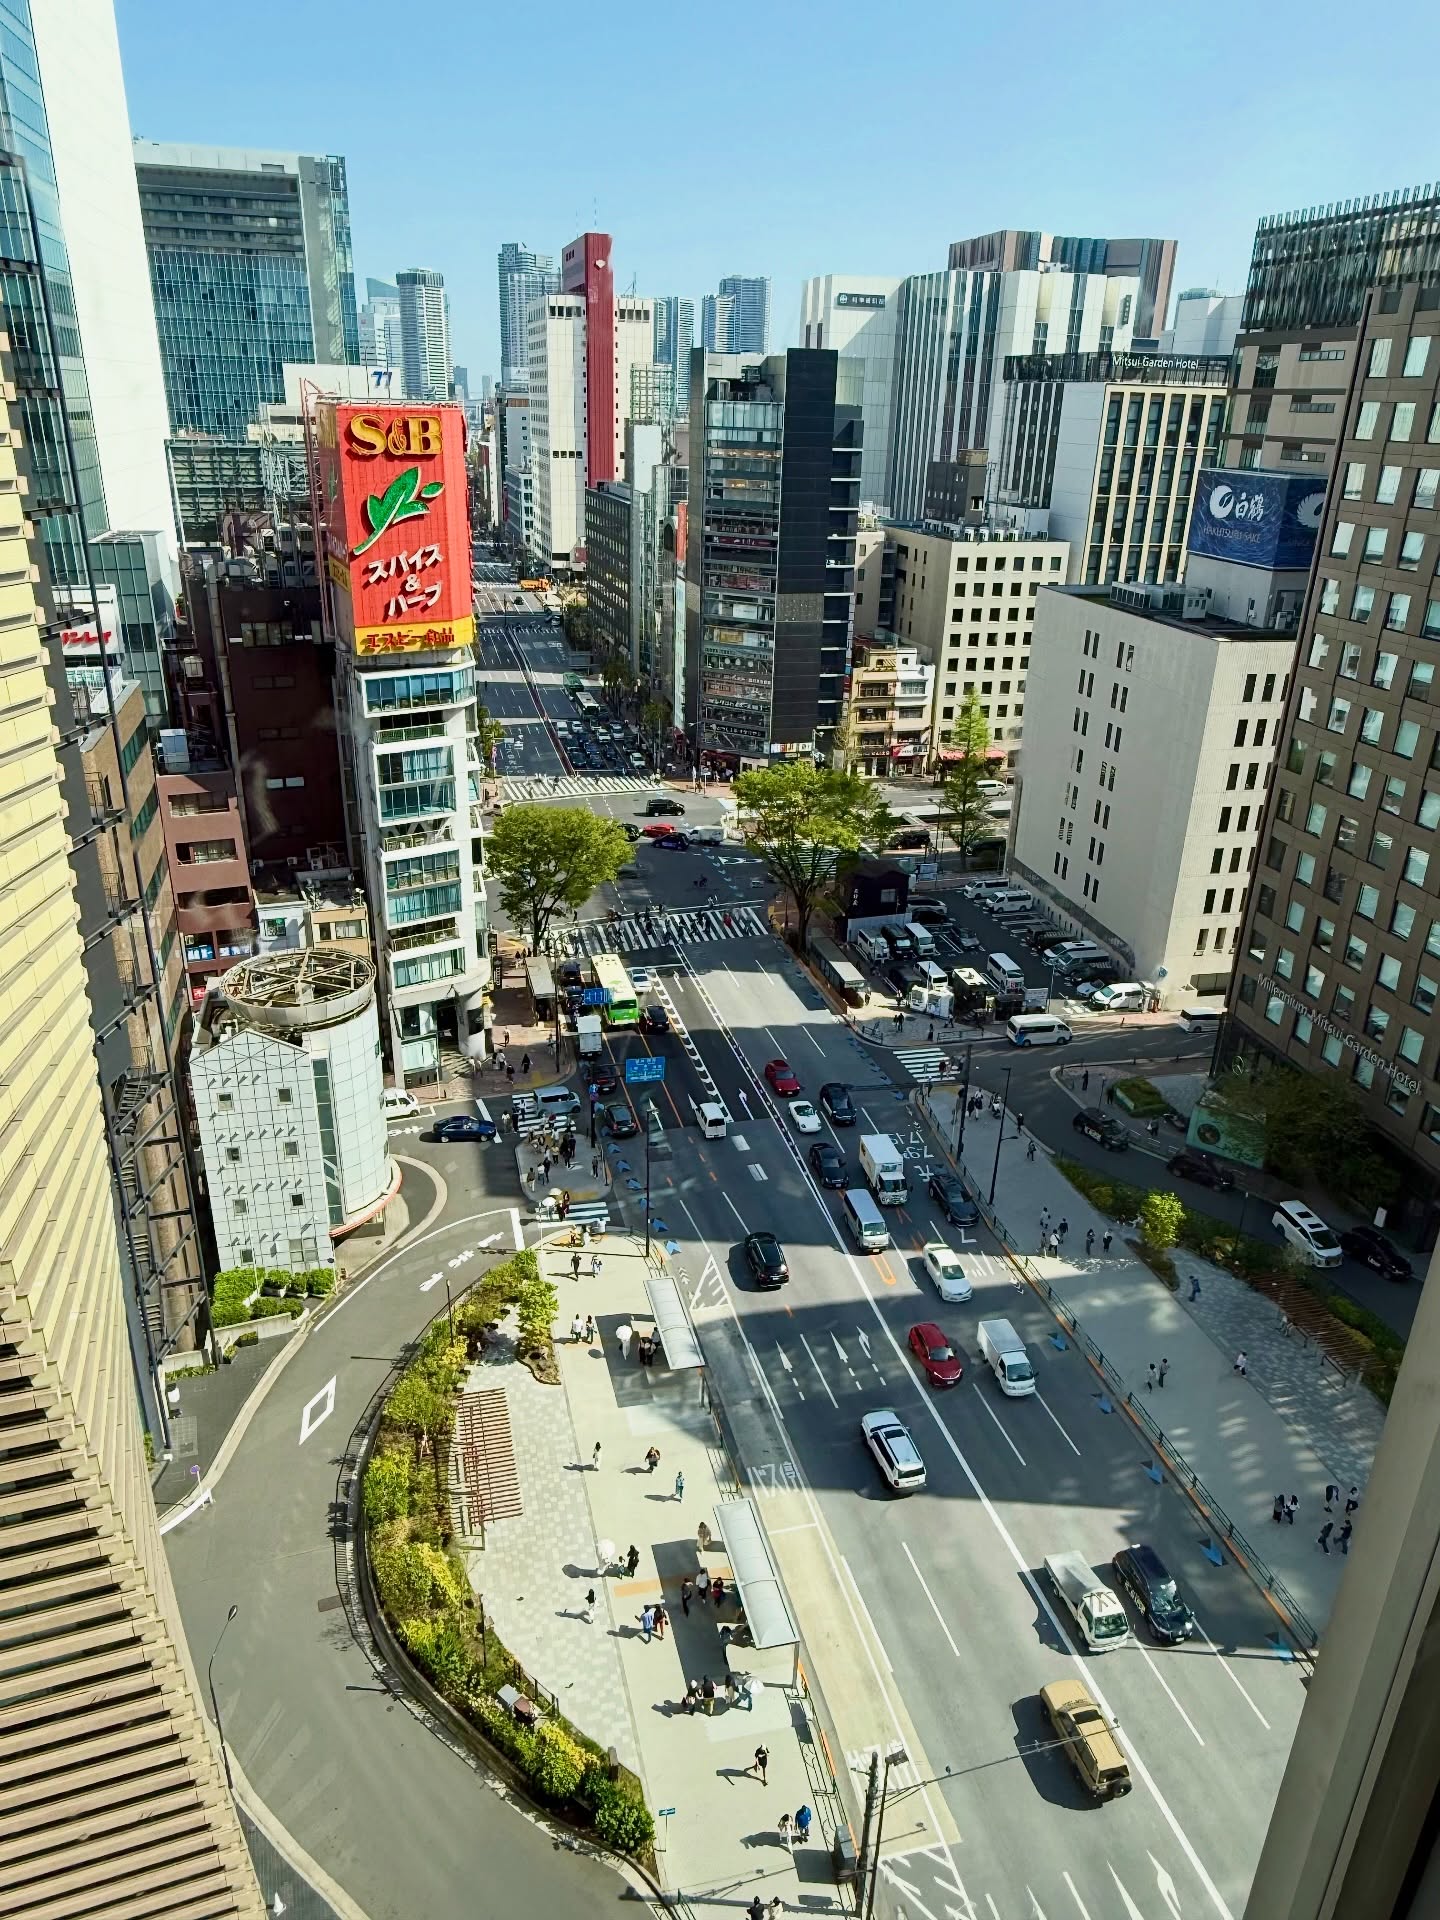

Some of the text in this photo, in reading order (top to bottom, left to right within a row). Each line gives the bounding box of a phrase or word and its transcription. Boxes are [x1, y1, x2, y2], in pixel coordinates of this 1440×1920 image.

[1112, 356, 1199, 370] Mitsui Garden Hotel
[350, 413, 442, 456] S&B
[368, 543, 443, 584] スパイス
[405, 573, 421, 592] &
[1257, 972, 1422, 1095] Millennium Mitsui Garden Hotel
